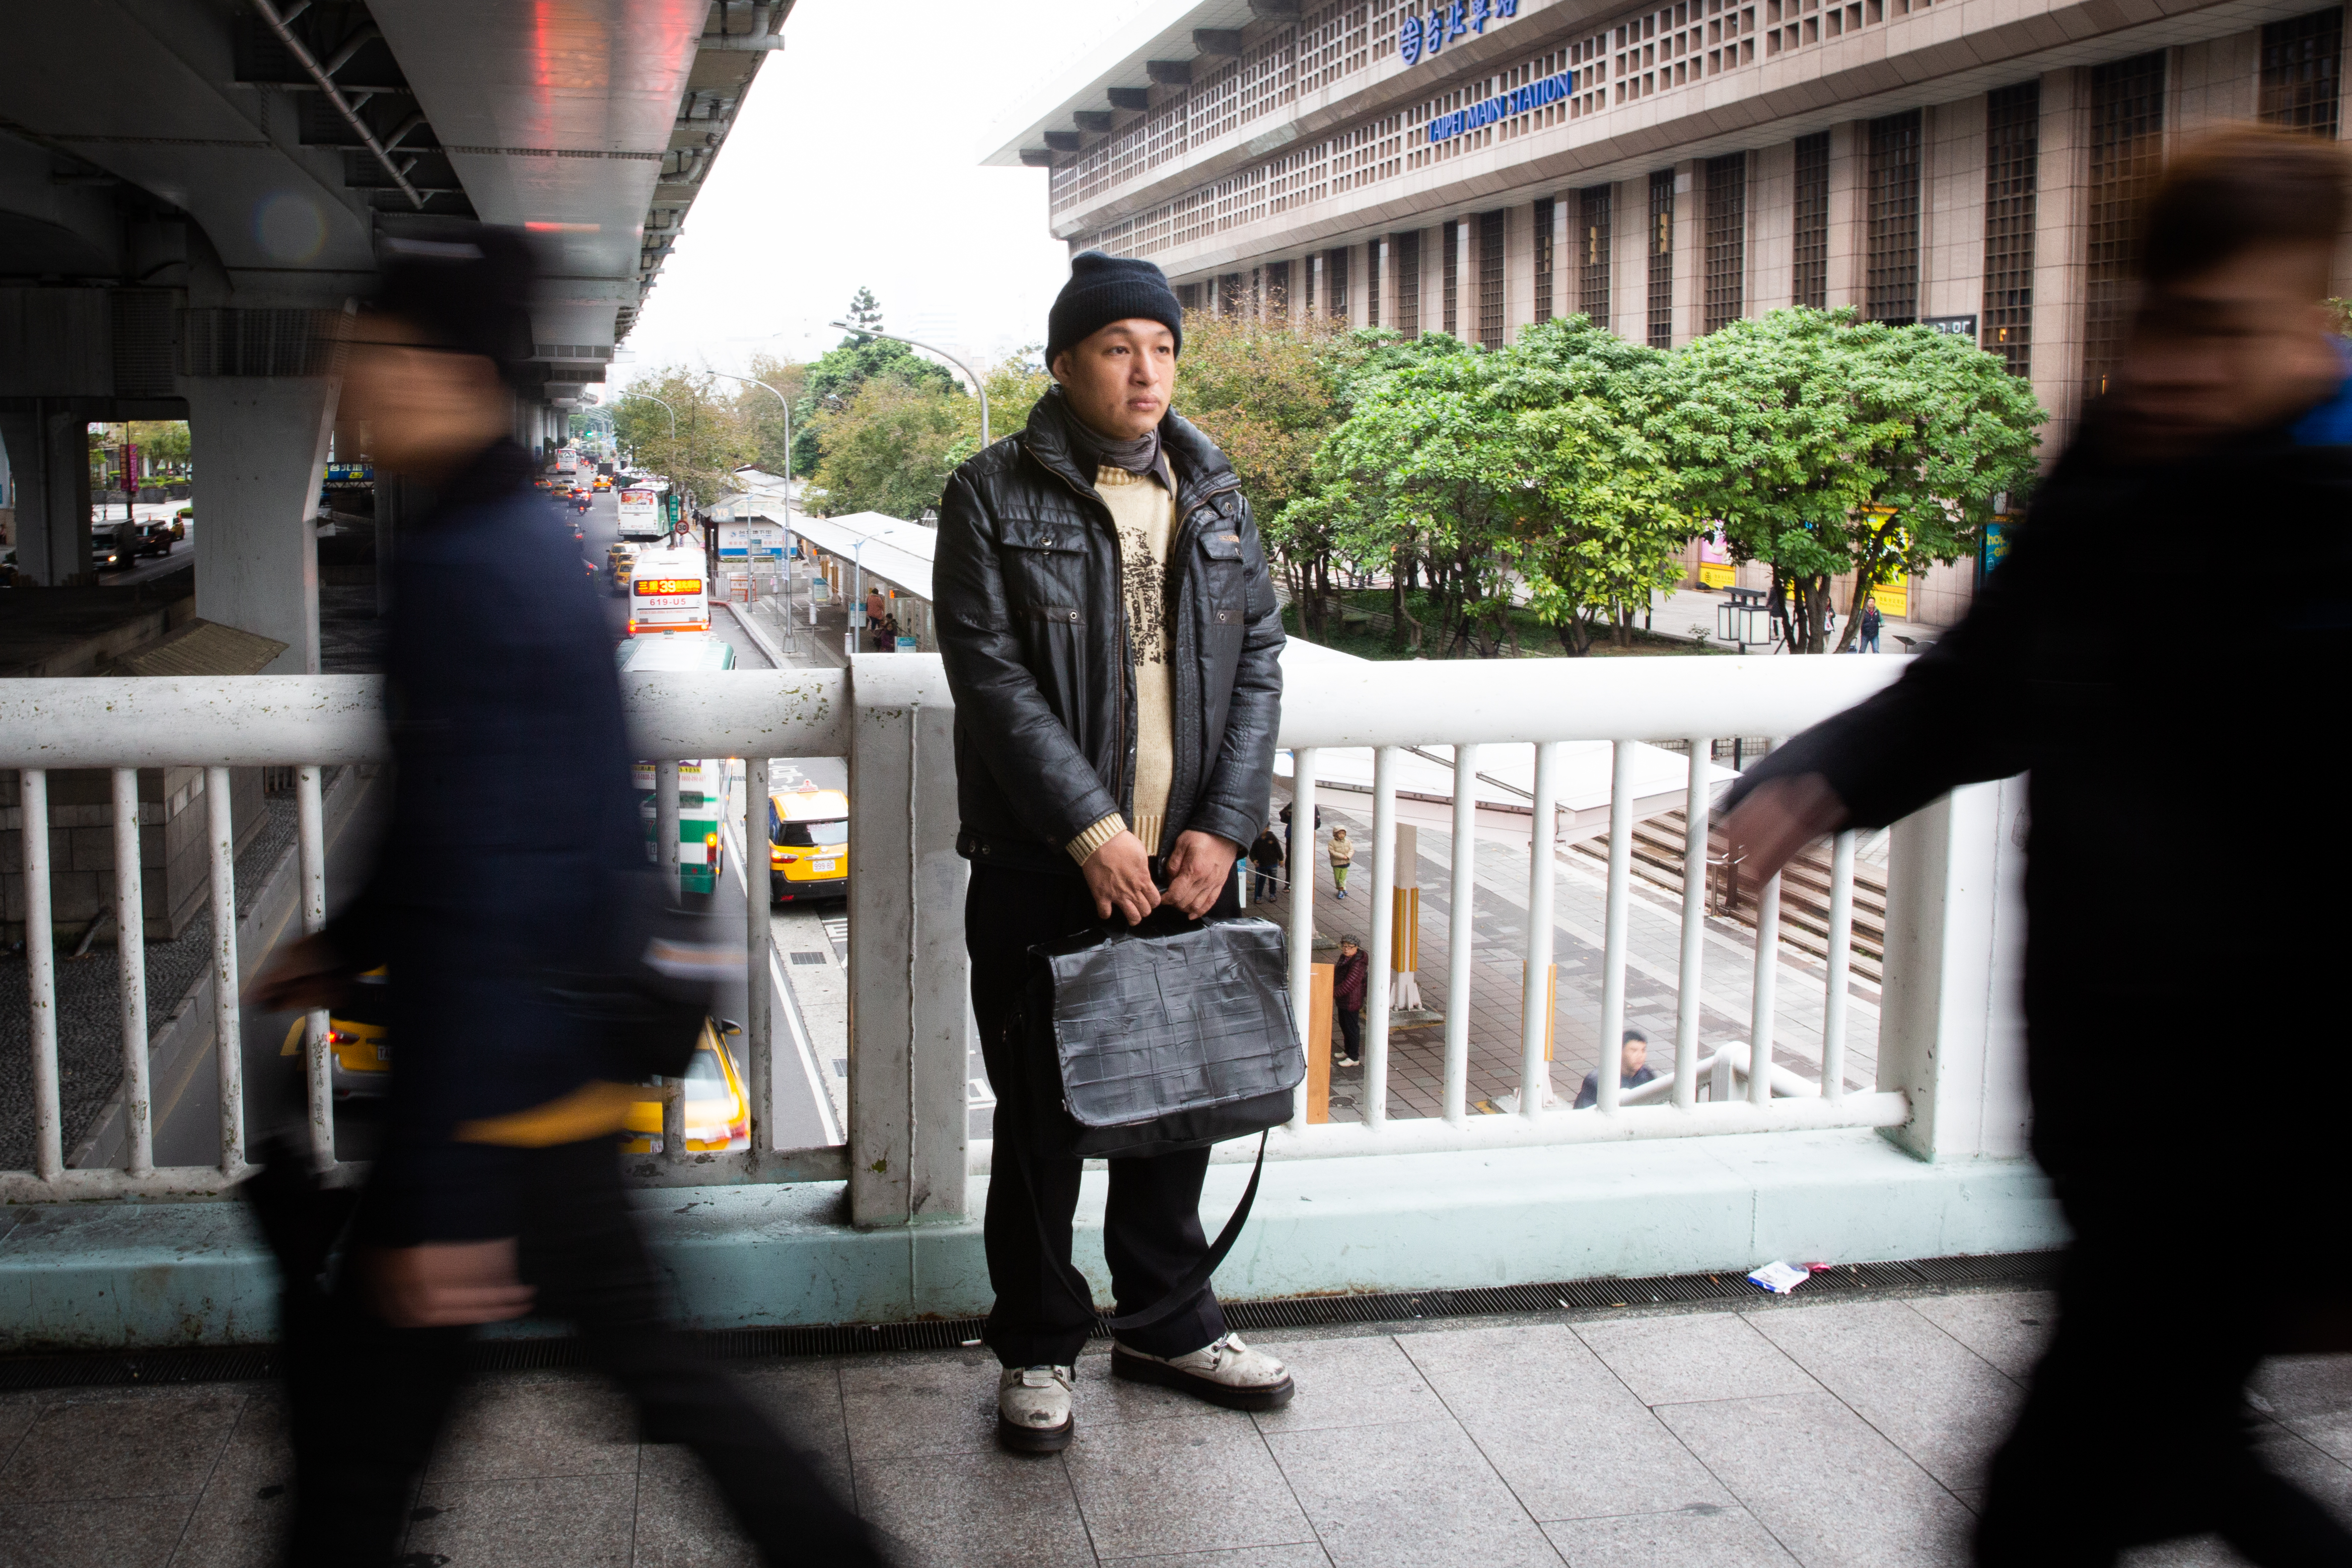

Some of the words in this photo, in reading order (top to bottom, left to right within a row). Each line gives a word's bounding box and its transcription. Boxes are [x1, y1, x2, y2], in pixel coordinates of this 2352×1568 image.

[1428, 110, 1464, 142] TAIPEI
[1467, 95, 1506, 129] MAIN
[1507, 70, 1572, 115] STATION
[716, 508, 729, 517] Y6
[659, 580, 676, 593] 39
